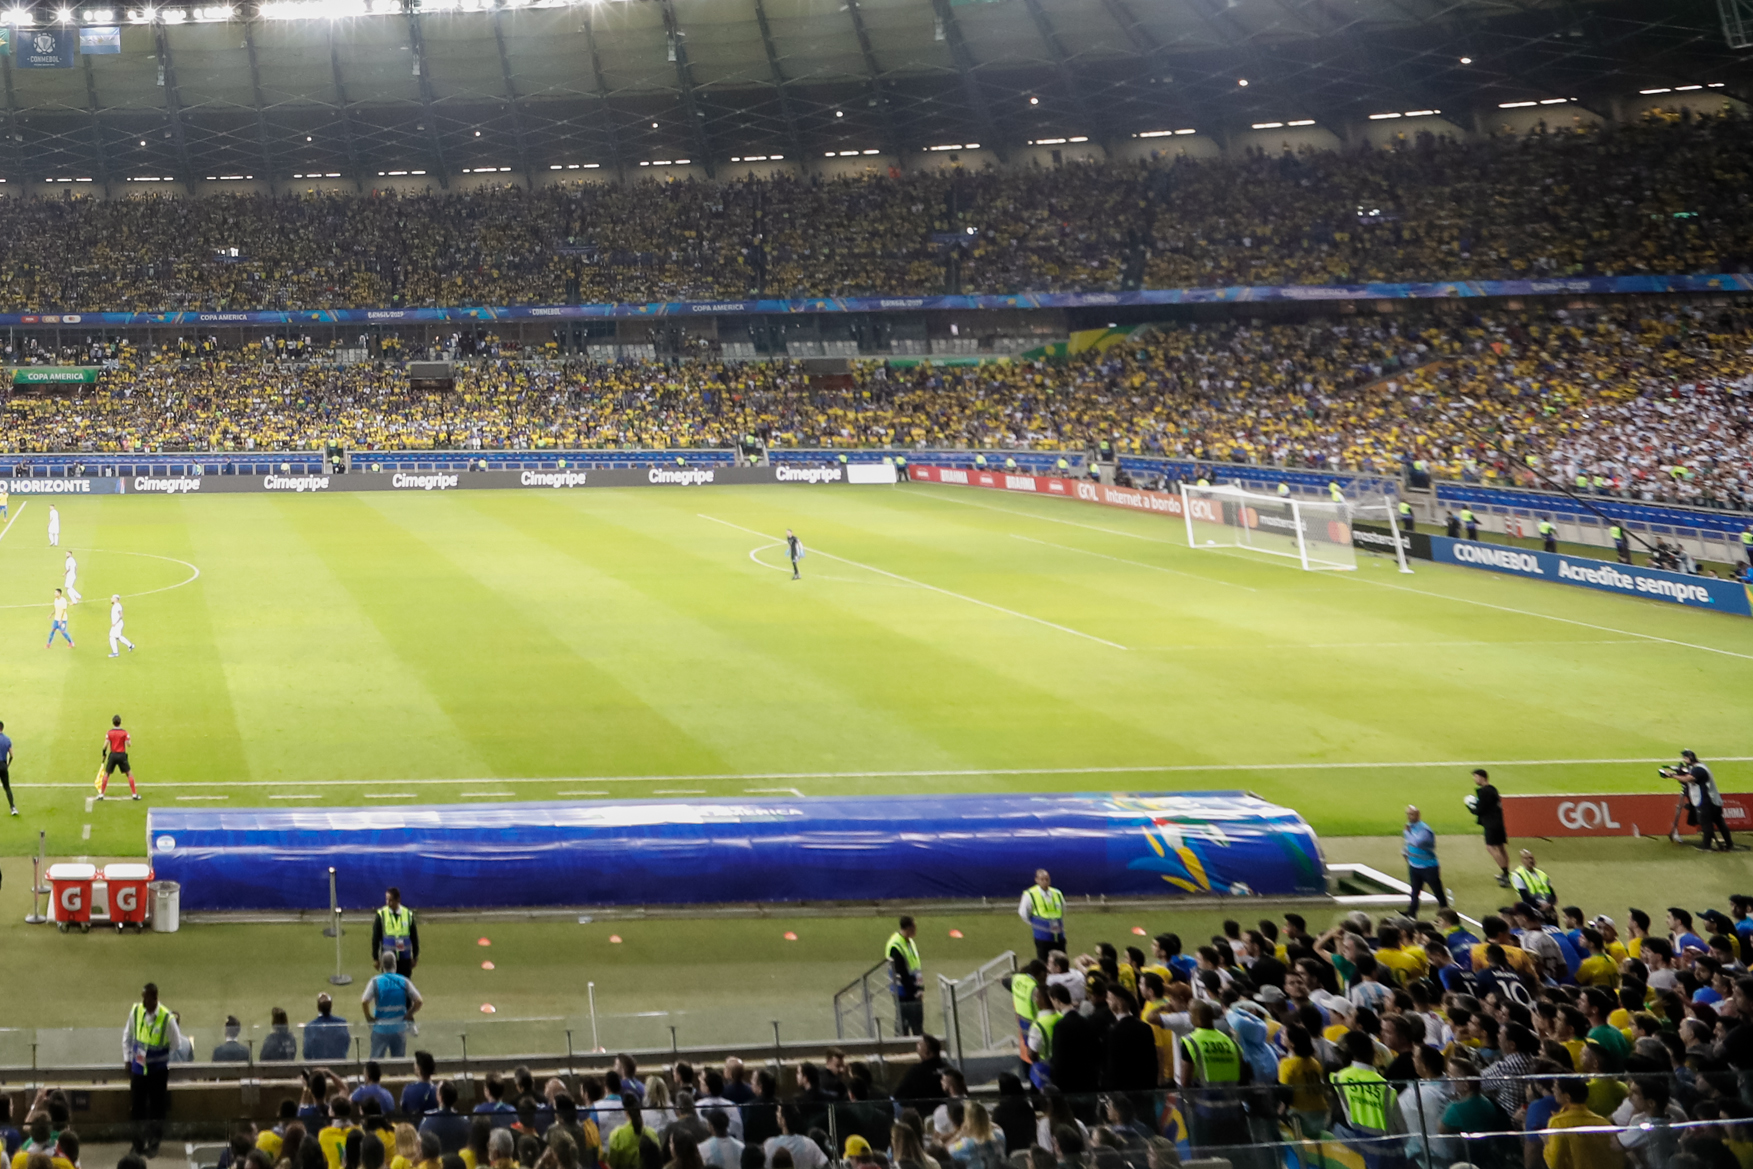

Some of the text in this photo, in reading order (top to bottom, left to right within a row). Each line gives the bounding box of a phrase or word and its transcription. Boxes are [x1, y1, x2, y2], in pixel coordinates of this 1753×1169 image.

[30, 55, 60, 64] CONMEBOL
[531, 308, 562, 316] CONMEBOL
[692, 304, 745, 313] COPA AMERICA
[263, 474, 329, 492] Cimegripe
[392, 473, 458, 490] Cimegripe
[520, 470, 586, 488] Cimegripe
[648, 467, 714, 485] Cimegripe
[776, 466, 841, 484] Cimegripe
[10, 480, 91, 492] HORIZONTE
[134, 476, 200, 493] Cimegripe
[1077, 483, 1099, 501] GOL
[1105, 488, 1182, 514] Internet a bordo
[1190, 500, 1216, 521] GOL
[1453, 543, 1544, 575] CONMEBOL
[1558, 560, 1715, 604] Acredite sempre.
[1557, 800, 1621, 831] GOL
[61, 887, 81, 912] G
[116, 887, 137, 912] G
[1496, 980, 1533, 1008] 10
